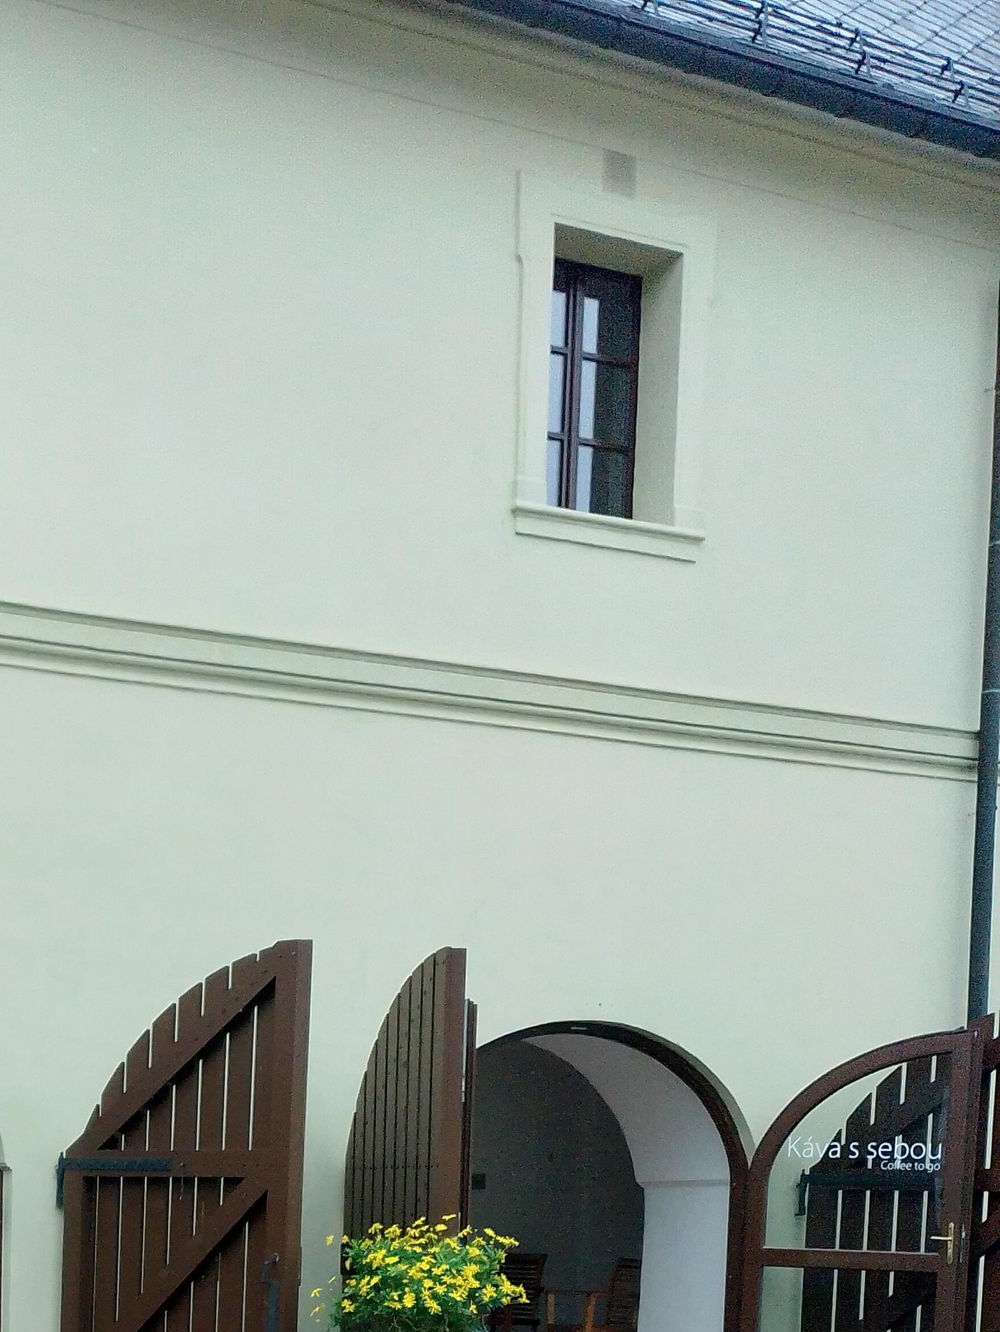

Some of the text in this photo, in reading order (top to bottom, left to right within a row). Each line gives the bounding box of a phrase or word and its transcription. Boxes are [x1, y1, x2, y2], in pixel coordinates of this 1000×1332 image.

[787, 1135, 942, 1160] Káva s sebou
[880, 1160, 941, 1174] Coffee to go
